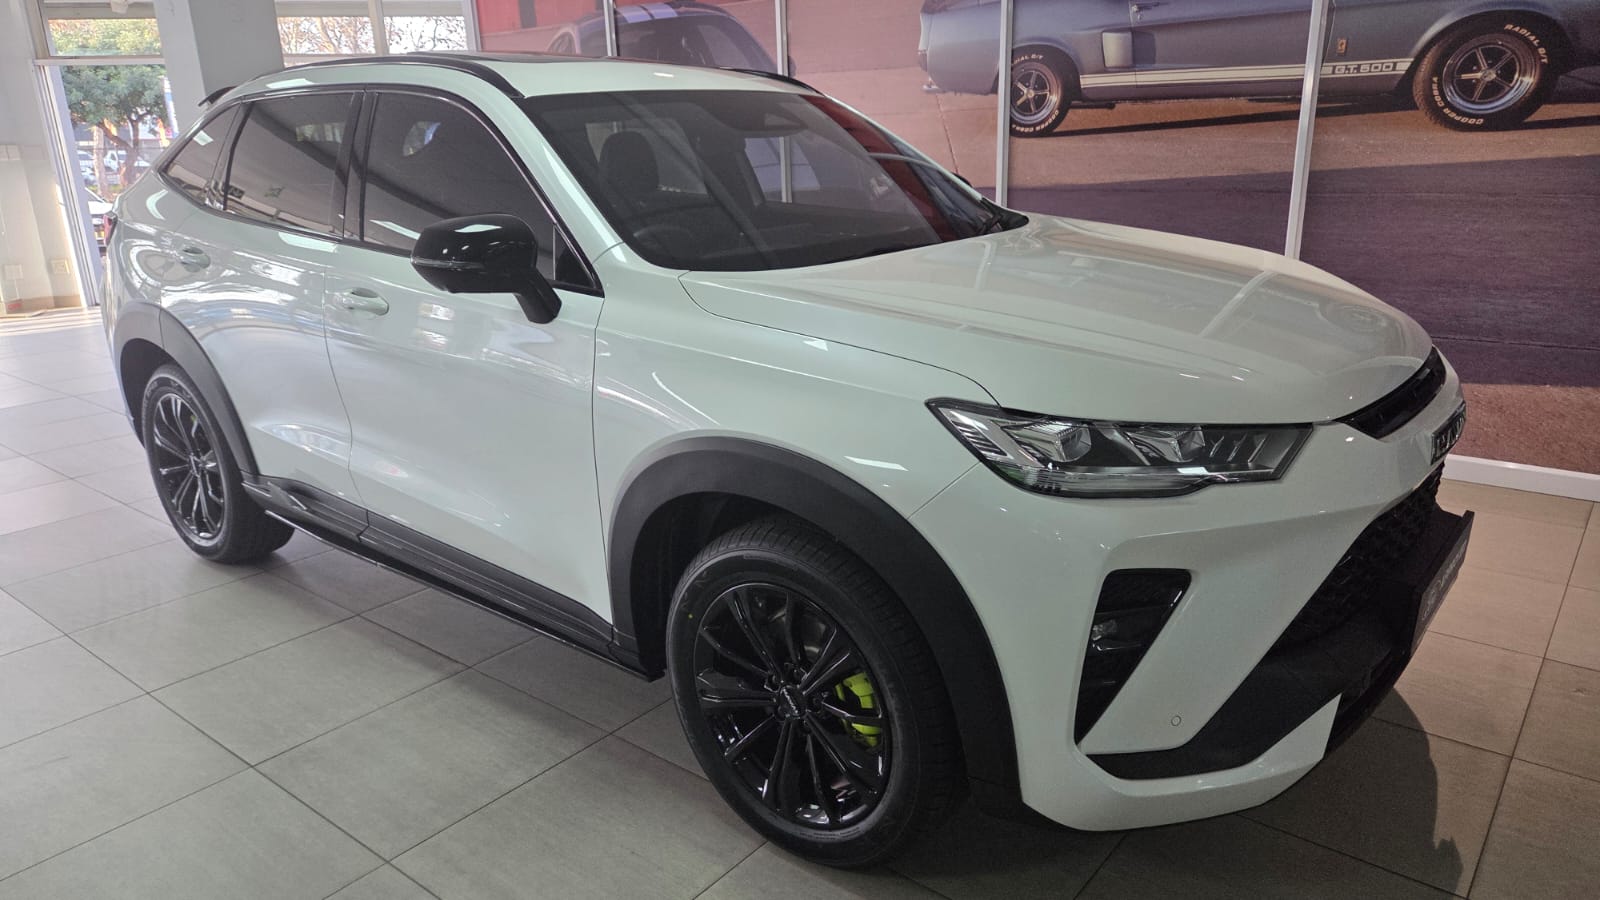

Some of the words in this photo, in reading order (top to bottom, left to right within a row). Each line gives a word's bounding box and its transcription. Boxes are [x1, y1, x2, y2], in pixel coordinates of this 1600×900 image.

[1503, 23, 1540, 47] RADIAL
[1360, 62, 1394, 72] 500
[1431, 76, 1445, 107] COBRA
[1443, 107, 1485, 126] COOPER
